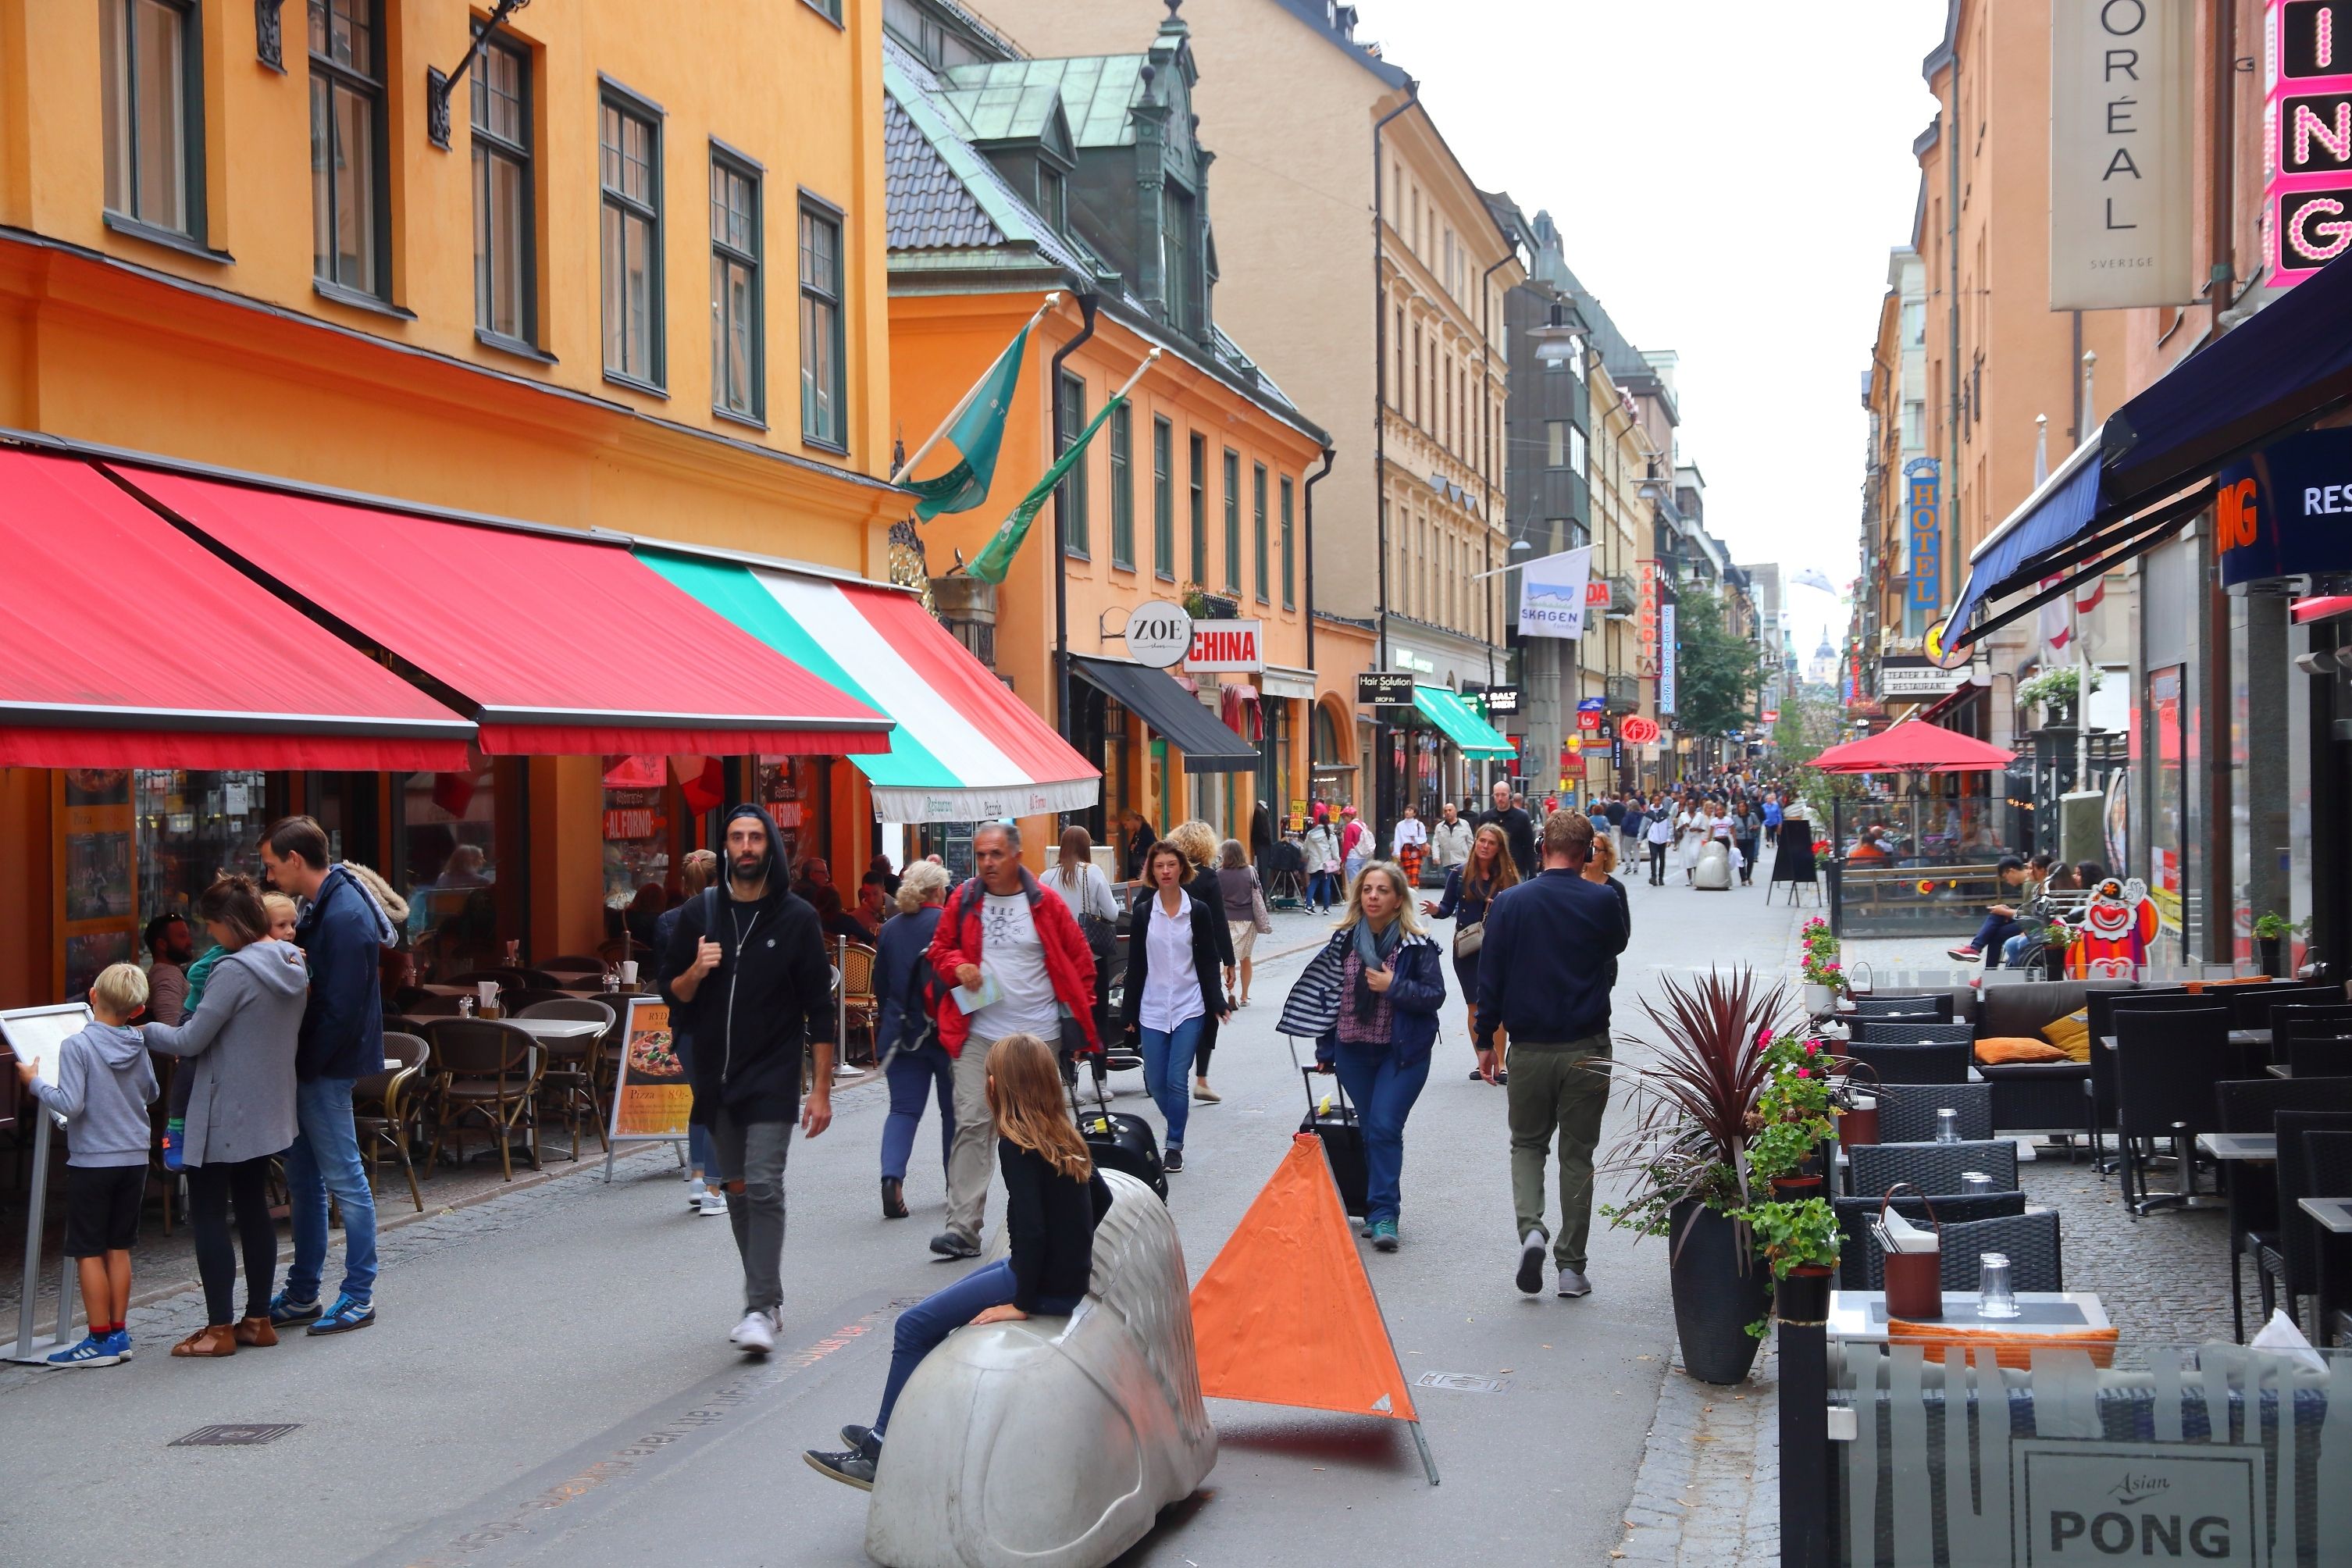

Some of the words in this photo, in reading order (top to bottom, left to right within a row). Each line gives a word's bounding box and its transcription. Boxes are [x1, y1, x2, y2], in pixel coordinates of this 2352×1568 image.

[2090, 257, 2154, 269] SVERIGE
[1912, 484, 1937, 602] HOTEL
[1521, 609, 1578, 622] SKAGEN
[1642, 567, 1655, 672] SKANDIA
[1134, 619, 1182, 640] ZOE
[1188, 632, 1256, 661] CHINA
[1360, 676, 1378, 686] Hair
[1379, 676, 1412, 686] Solution
[1893, 682, 1948, 691] RESTAURANT
[609, 811, 622, 839] AL
[622, 811, 652, 838] FORNO
[779, 802, 802, 828] FORNO
[630, 1089, 655, 1100] Pizza
[2109, 1472, 2171, 1495] Asian
[2050, 1510, 2231, 1559] PONG
